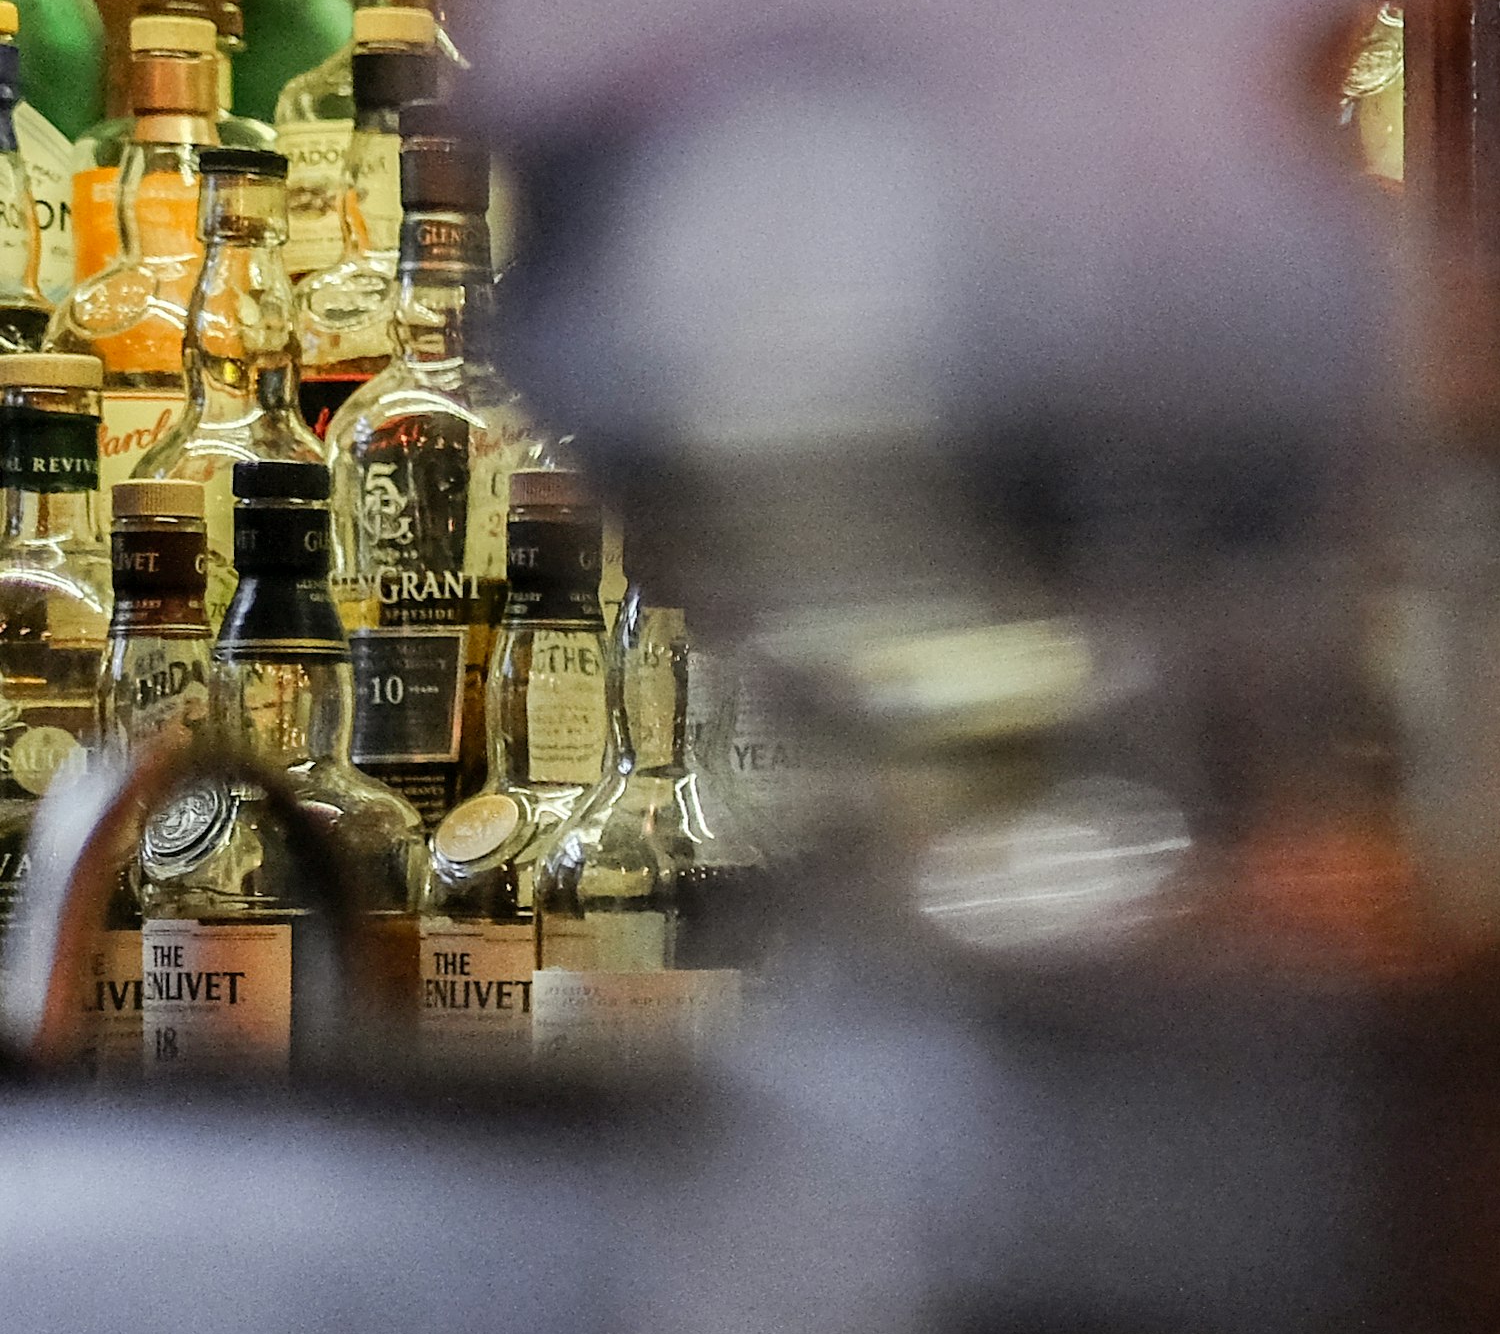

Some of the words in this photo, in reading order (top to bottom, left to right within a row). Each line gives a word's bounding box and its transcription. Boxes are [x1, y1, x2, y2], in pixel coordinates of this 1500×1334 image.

[369, 674, 404, 705] 10
[151, 945, 185, 968] THE
[433, 952, 471, 977] THE
[155, 1026, 179, 1061] 18
